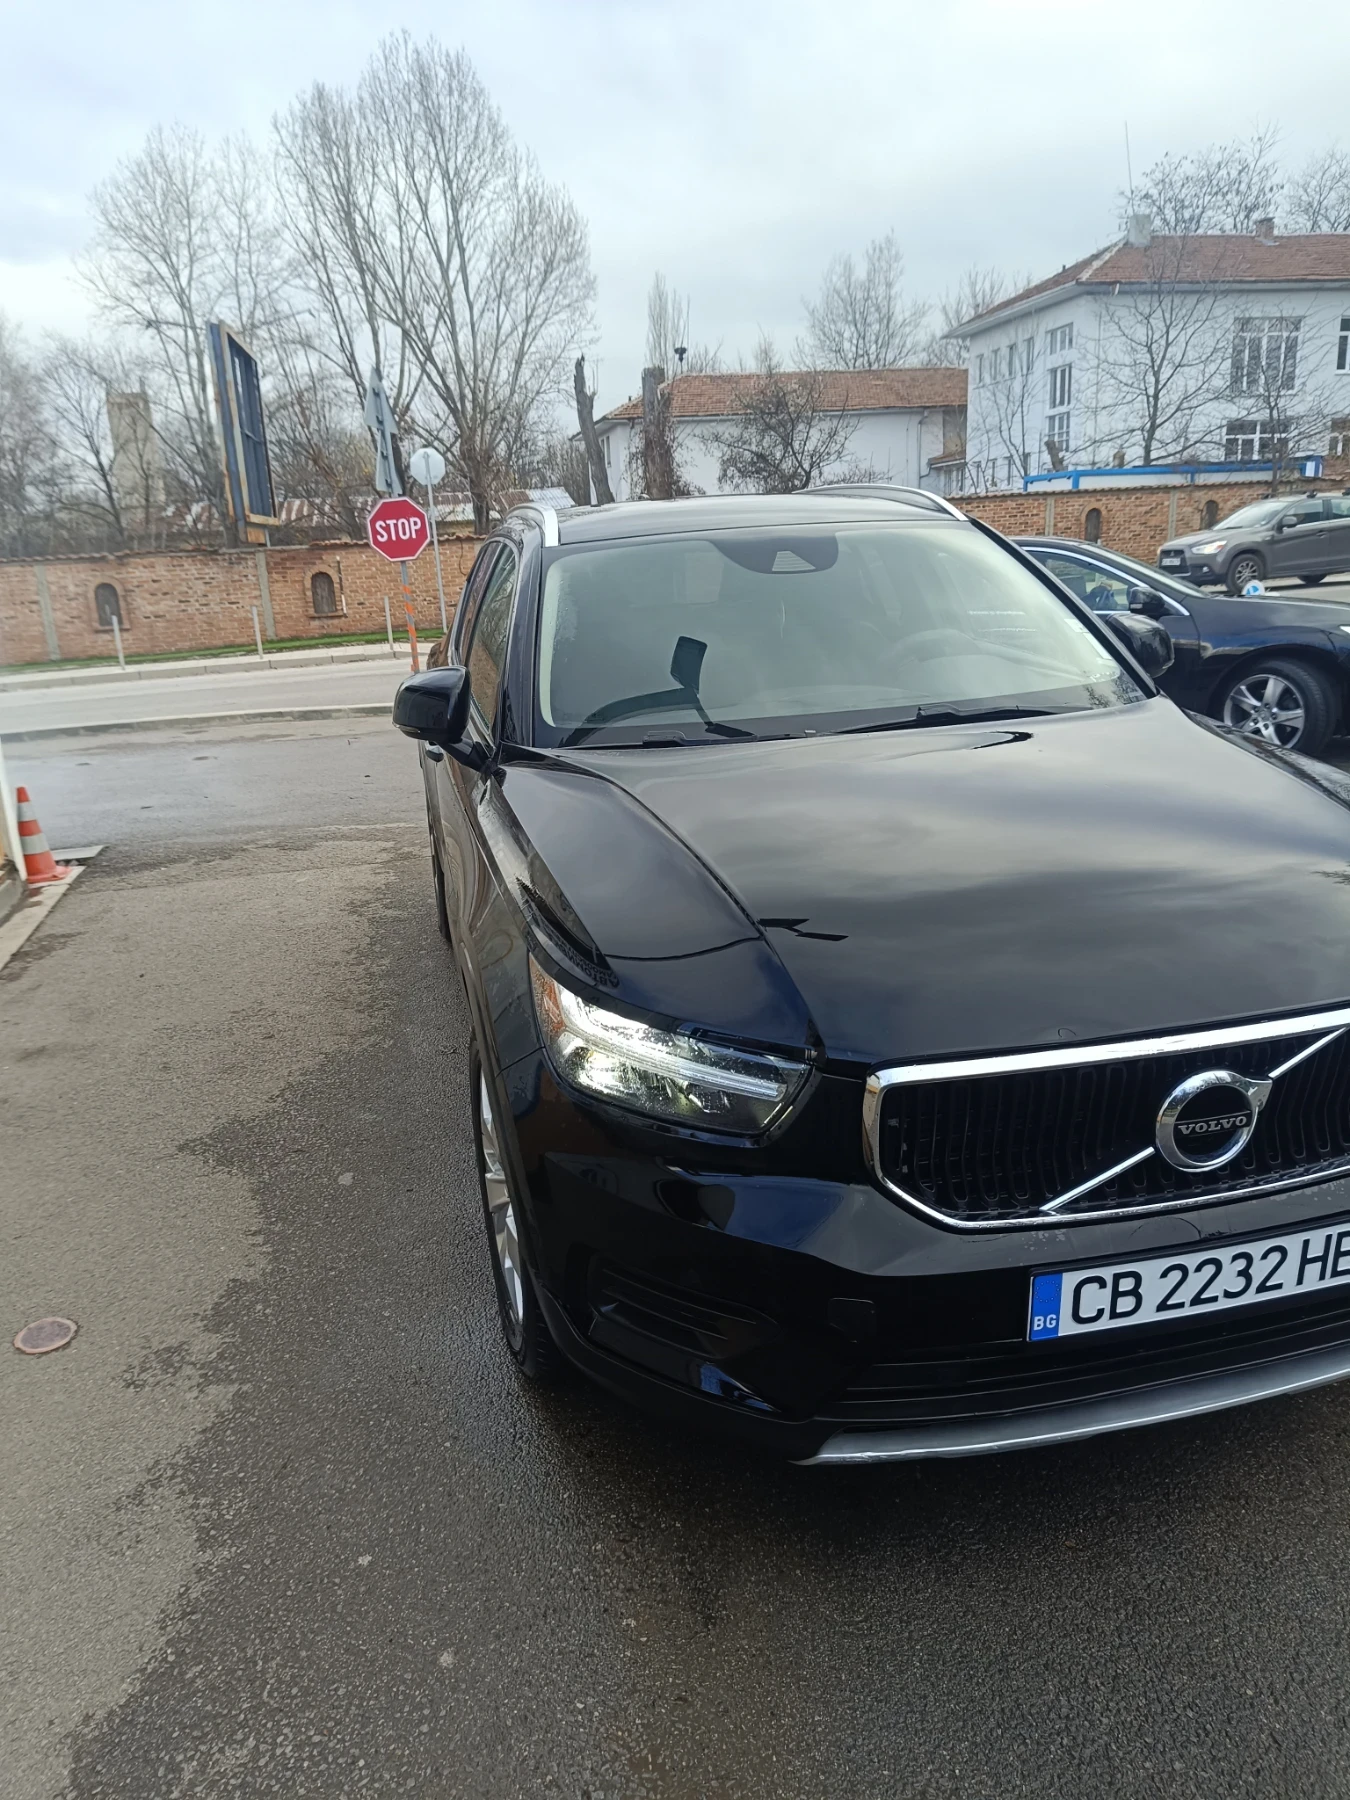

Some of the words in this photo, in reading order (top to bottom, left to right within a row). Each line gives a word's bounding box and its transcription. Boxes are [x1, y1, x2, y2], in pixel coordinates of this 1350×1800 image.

[375, 517, 421, 542] STOP
[1178, 1116, 1247, 1135] VOLVO
[1071, 1270, 1143, 1325] CB
[1155, 1245, 1289, 1313] 2232
[1033, 1314, 1057, 1330] BG
